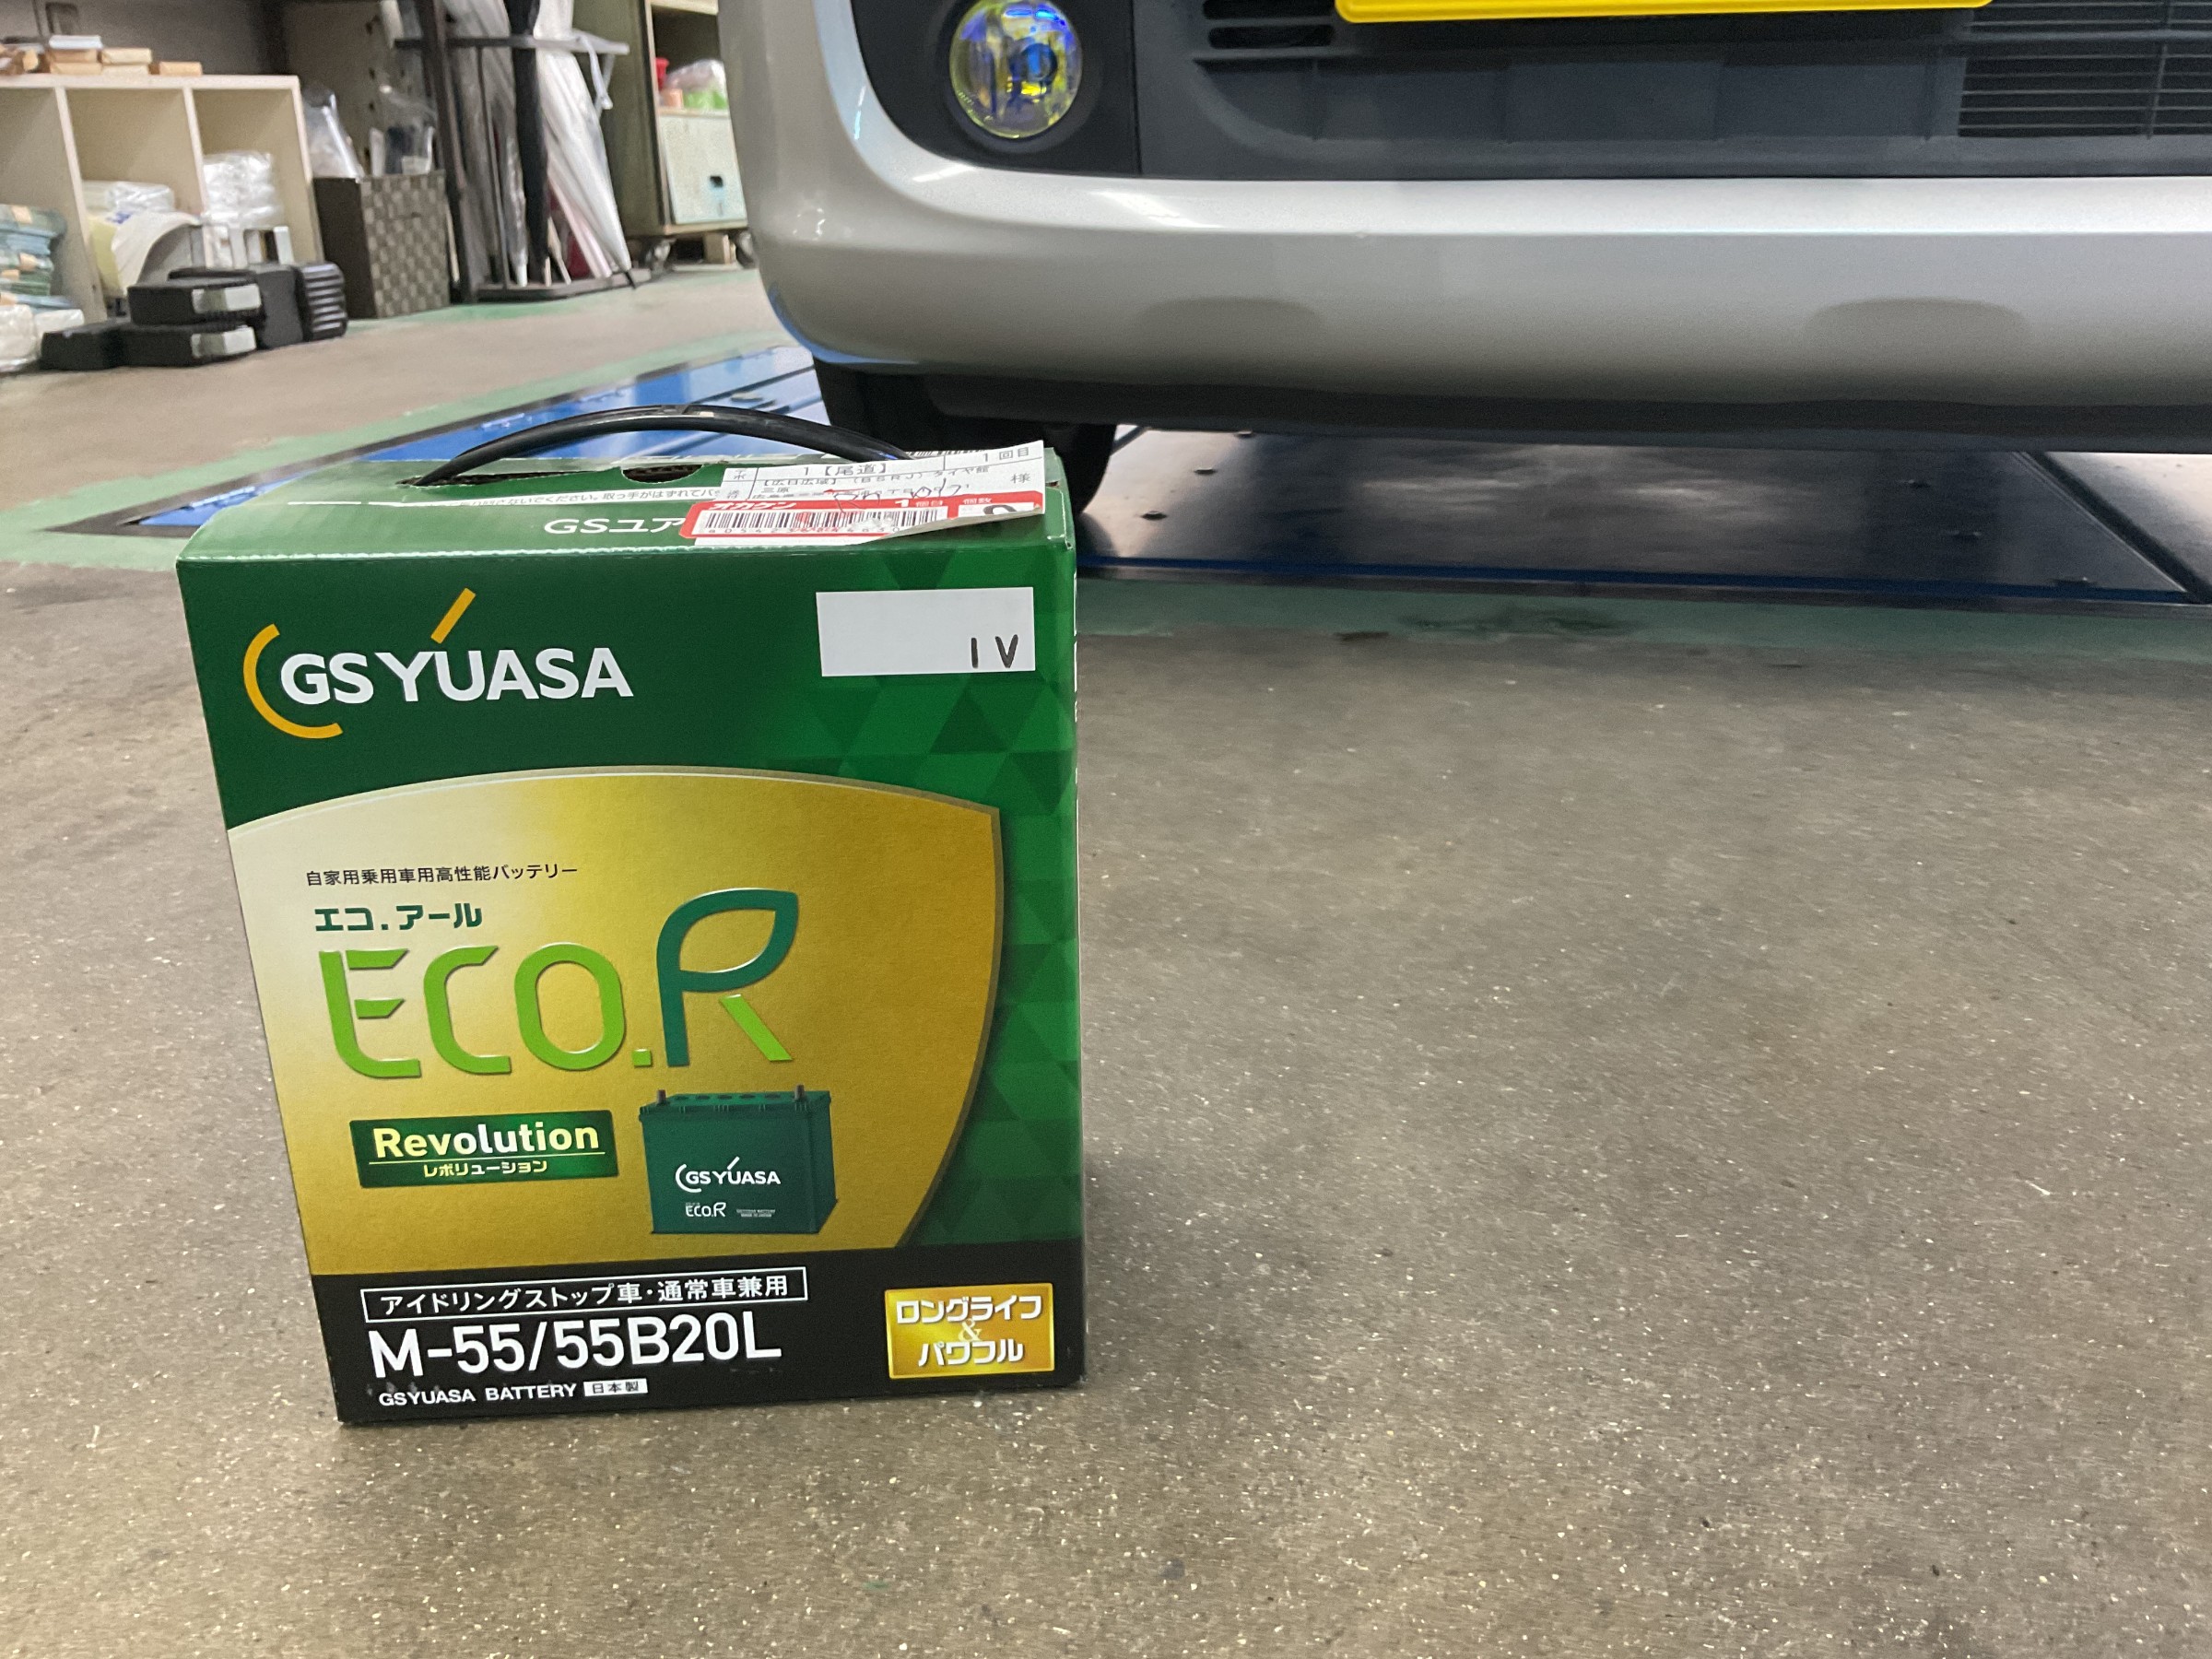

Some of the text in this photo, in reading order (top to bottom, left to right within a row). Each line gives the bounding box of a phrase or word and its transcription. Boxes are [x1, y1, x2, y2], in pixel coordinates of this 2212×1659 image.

[1011, 473, 1031, 483] 様
[306, 863, 579, 886] 自家用乗用車用高性能バッテリー
[373, 1122, 599, 1159] Revolution
[423, 1160, 547, 1178] レボリューション
[381, 1275, 788, 1315] アイドリングストップ車・通常車兼用
[896, 1294, 1042, 1324] ロングライフ
[958, 1318, 982, 1343] &
[369, 1311, 782, 1379] M-55/55B20L
[918, 1338, 1024, 1367] パワフル
[485, 1383, 578, 1402] BATTERY
[591, 1380, 641, 1395] 日本製
